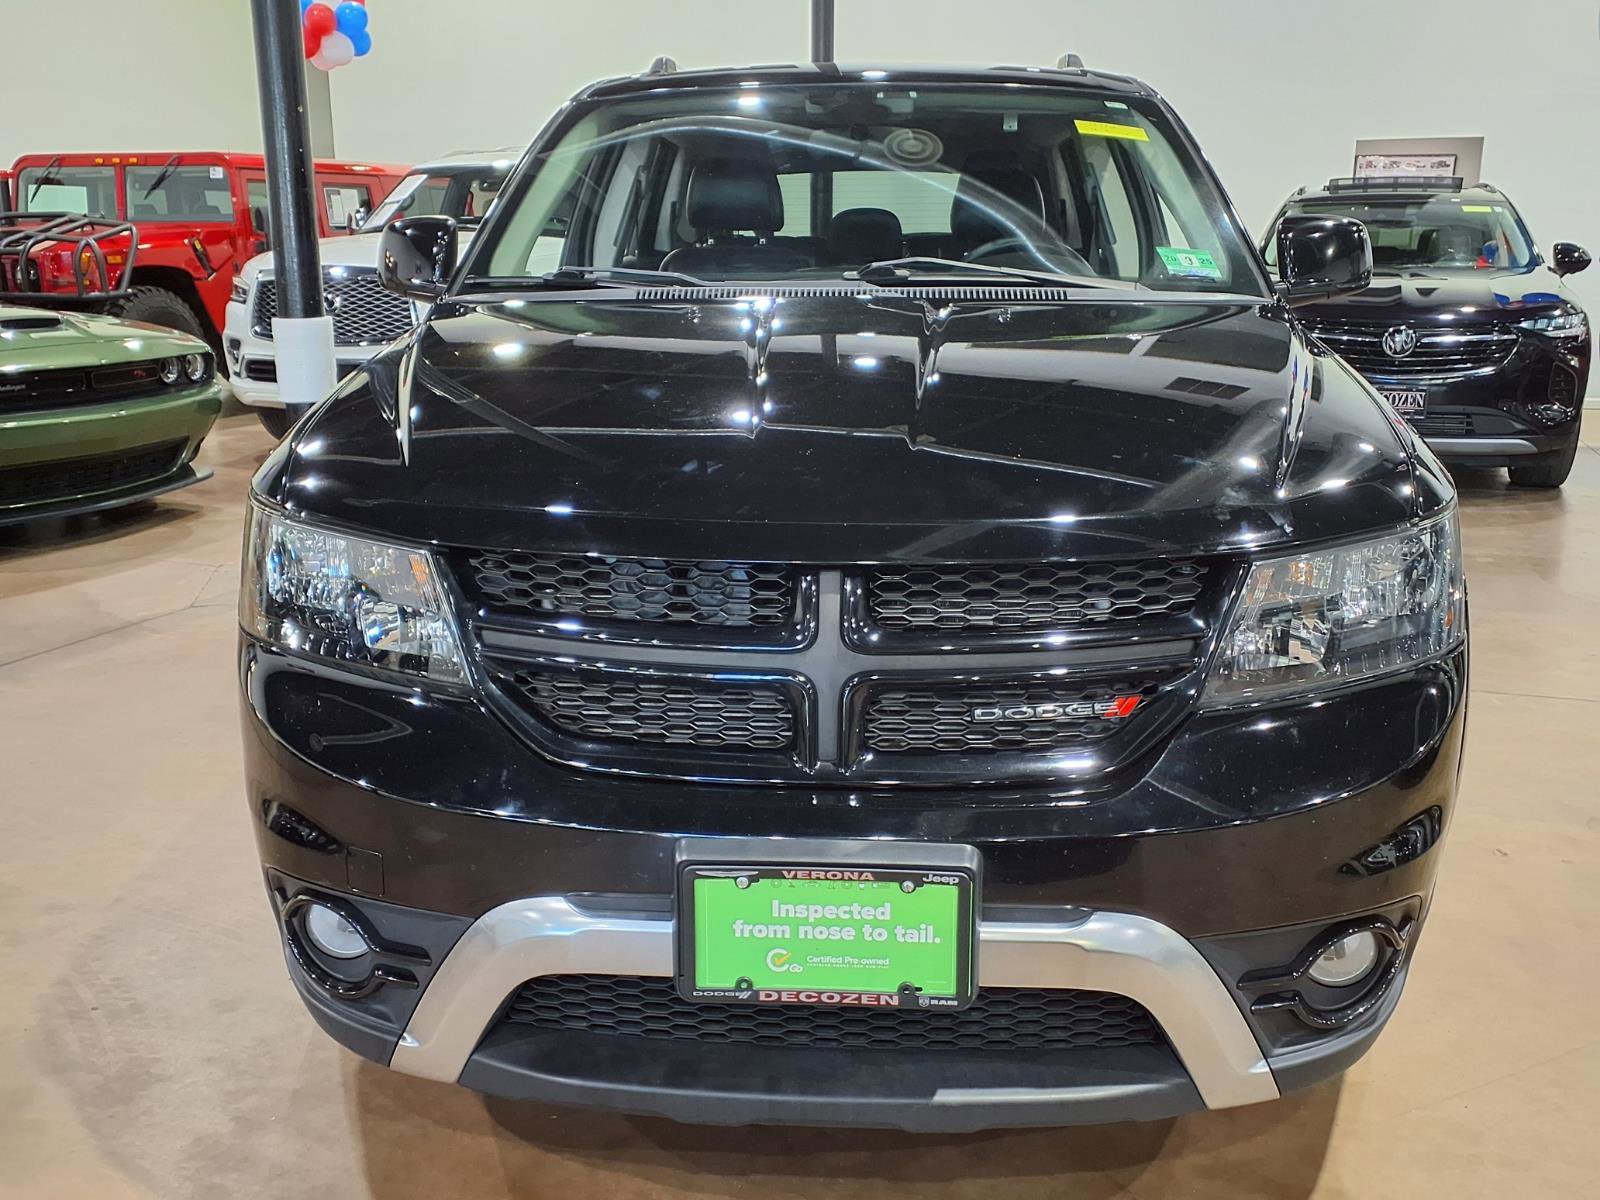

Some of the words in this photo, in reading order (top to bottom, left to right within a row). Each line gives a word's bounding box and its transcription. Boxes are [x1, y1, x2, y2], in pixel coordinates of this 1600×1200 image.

[974, 701, 1118, 721] DODGE
[781, 870, 875, 881] VERONA
[922, 873, 960, 885] Jeep
[772, 900, 892, 923] Inspected
[732, 920, 791, 939] from
[798, 925, 856, 941] nose
[862, 924, 888, 942] to
[894, 924, 942, 944] tail.
[806, 955, 843, 964] Certified
[758, 990, 900, 1006] DECOZEN
